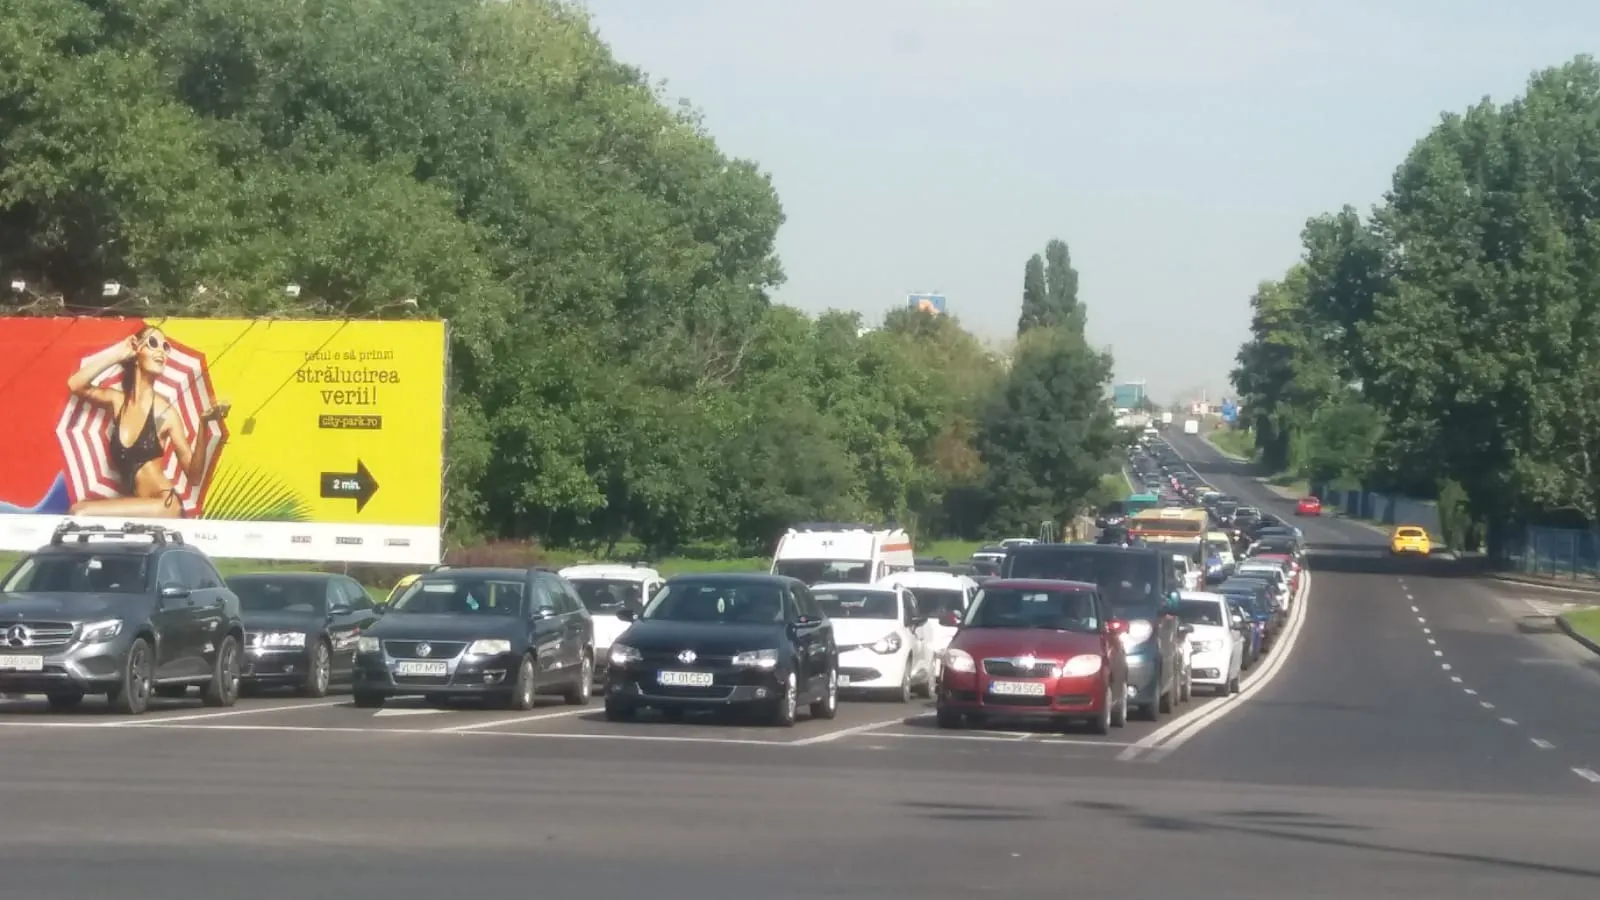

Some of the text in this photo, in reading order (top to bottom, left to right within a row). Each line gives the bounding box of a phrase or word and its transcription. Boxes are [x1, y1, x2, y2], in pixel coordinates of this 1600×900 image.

[296, 365, 401, 384] strălucirea
[320, 385, 377, 406] verii!
[321, 415, 378, 428] city-park.ro
[333, 479, 361, 490] 2 min.
[663, 673, 674, 682] CT
